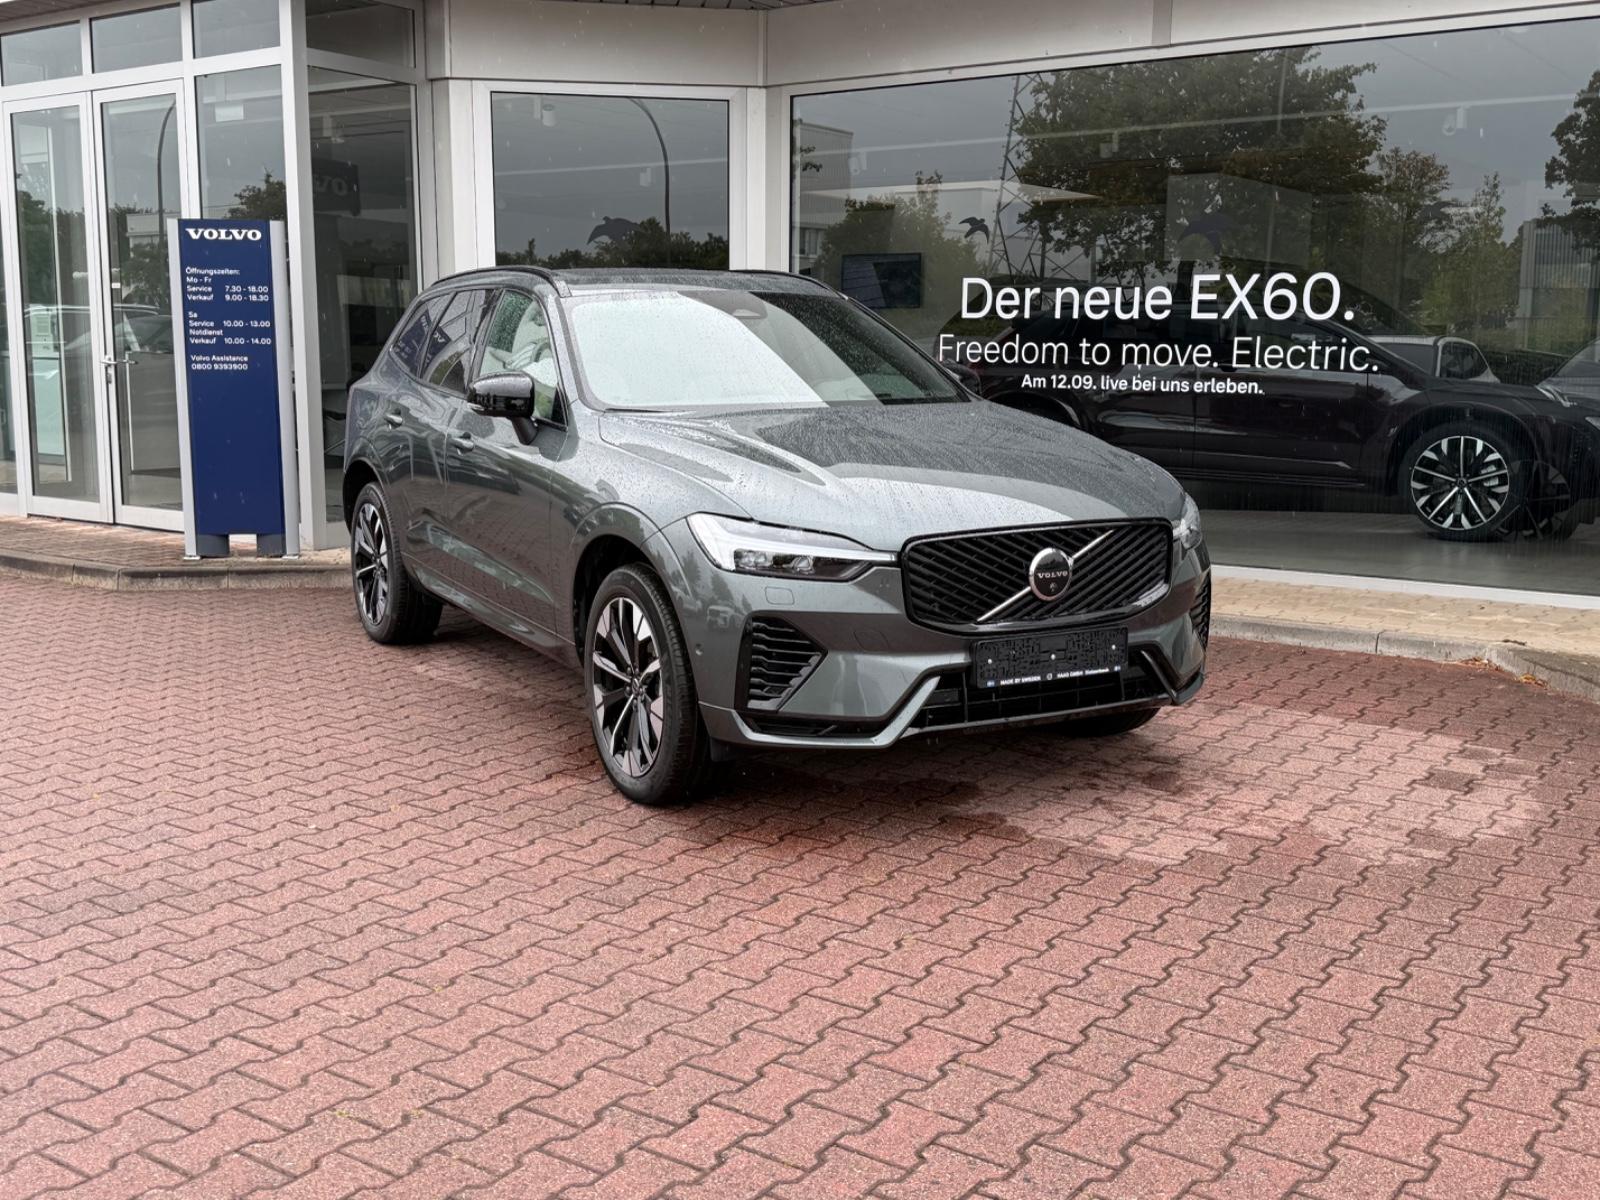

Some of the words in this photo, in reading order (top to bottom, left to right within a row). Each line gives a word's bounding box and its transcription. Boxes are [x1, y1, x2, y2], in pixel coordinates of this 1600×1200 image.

[185, 228, 262, 241] VOLVO
[185, 266, 240, 276] Öffnungszeiten:
[225, 285, 242, 293] 7.30
[961, 277, 1041, 320] Der
[1055, 284, 1172, 320] neue
[1190, 271, 1354, 321] EX60.
[938, 333, 1068, 365] Freedom
[1080, 338, 1110, 366] to
[1121, 343, 1219, 369] move.
[1231, 336, 1379, 372] Electric.
[1021, 374, 1046, 389] Am
[1050, 374, 1097, 390] 12.09.
[1101, 375, 1128, 391] live
[1132, 375, 1156, 392] bei
[1160, 379, 1190, 393] uns
[1193, 377, 1264, 395] erleben.
[1037, 570, 1068, 578] VOLVO
